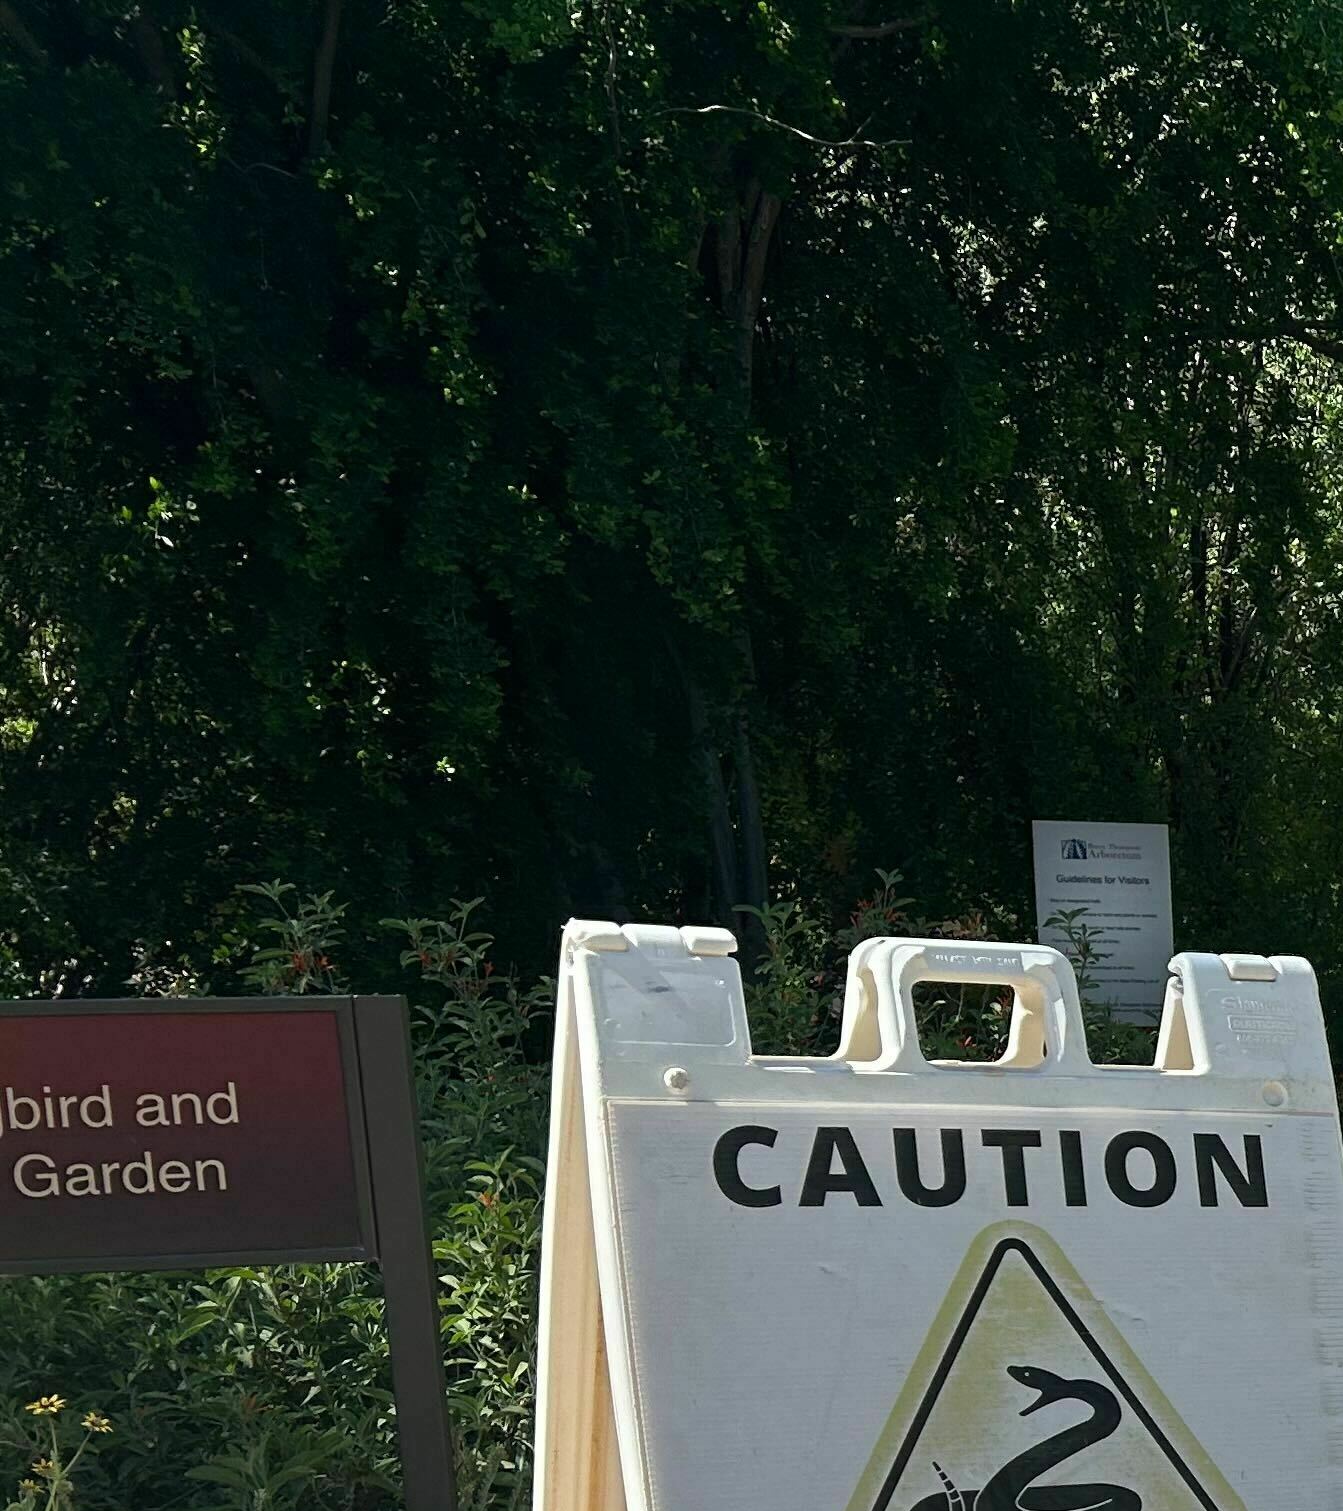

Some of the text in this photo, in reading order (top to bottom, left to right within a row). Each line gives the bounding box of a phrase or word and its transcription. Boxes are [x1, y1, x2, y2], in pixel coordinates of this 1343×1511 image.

[1056, 874, 1150, 885] Guidelines for Visitors
[0, 1081, 239, 1138] bird and
[13, 1151, 227, 1198] Garden
[713, 1125, 1269, 1207] CAUTION
